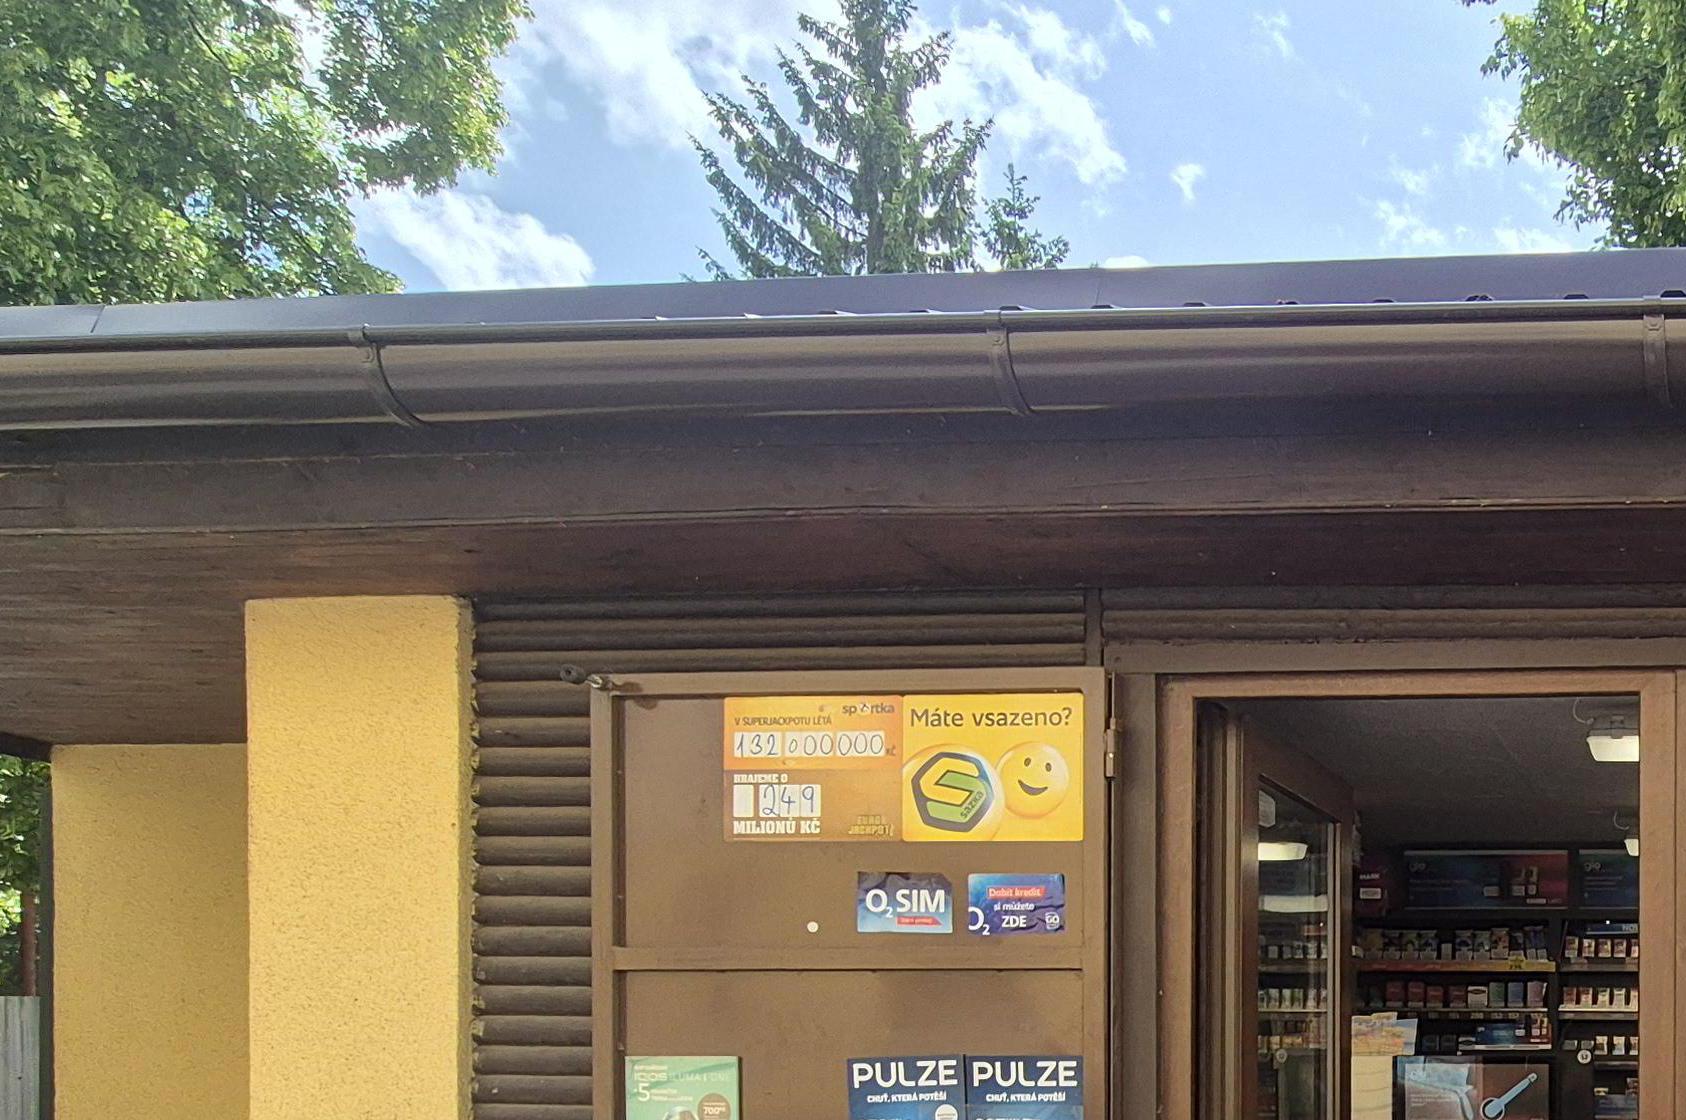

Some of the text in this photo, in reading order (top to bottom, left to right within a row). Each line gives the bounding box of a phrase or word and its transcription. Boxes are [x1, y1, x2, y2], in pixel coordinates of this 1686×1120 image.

[910, 706, 1072, 727] Máte vsazeno?
[733, 818, 796, 834] MILIONŮ
[896, 889, 945, 913] SIM
[1002, 915, 1027, 928] ZDE
[852, 1060, 958, 1089] PULZE
[972, 1060, 1078, 1087] PULZE
